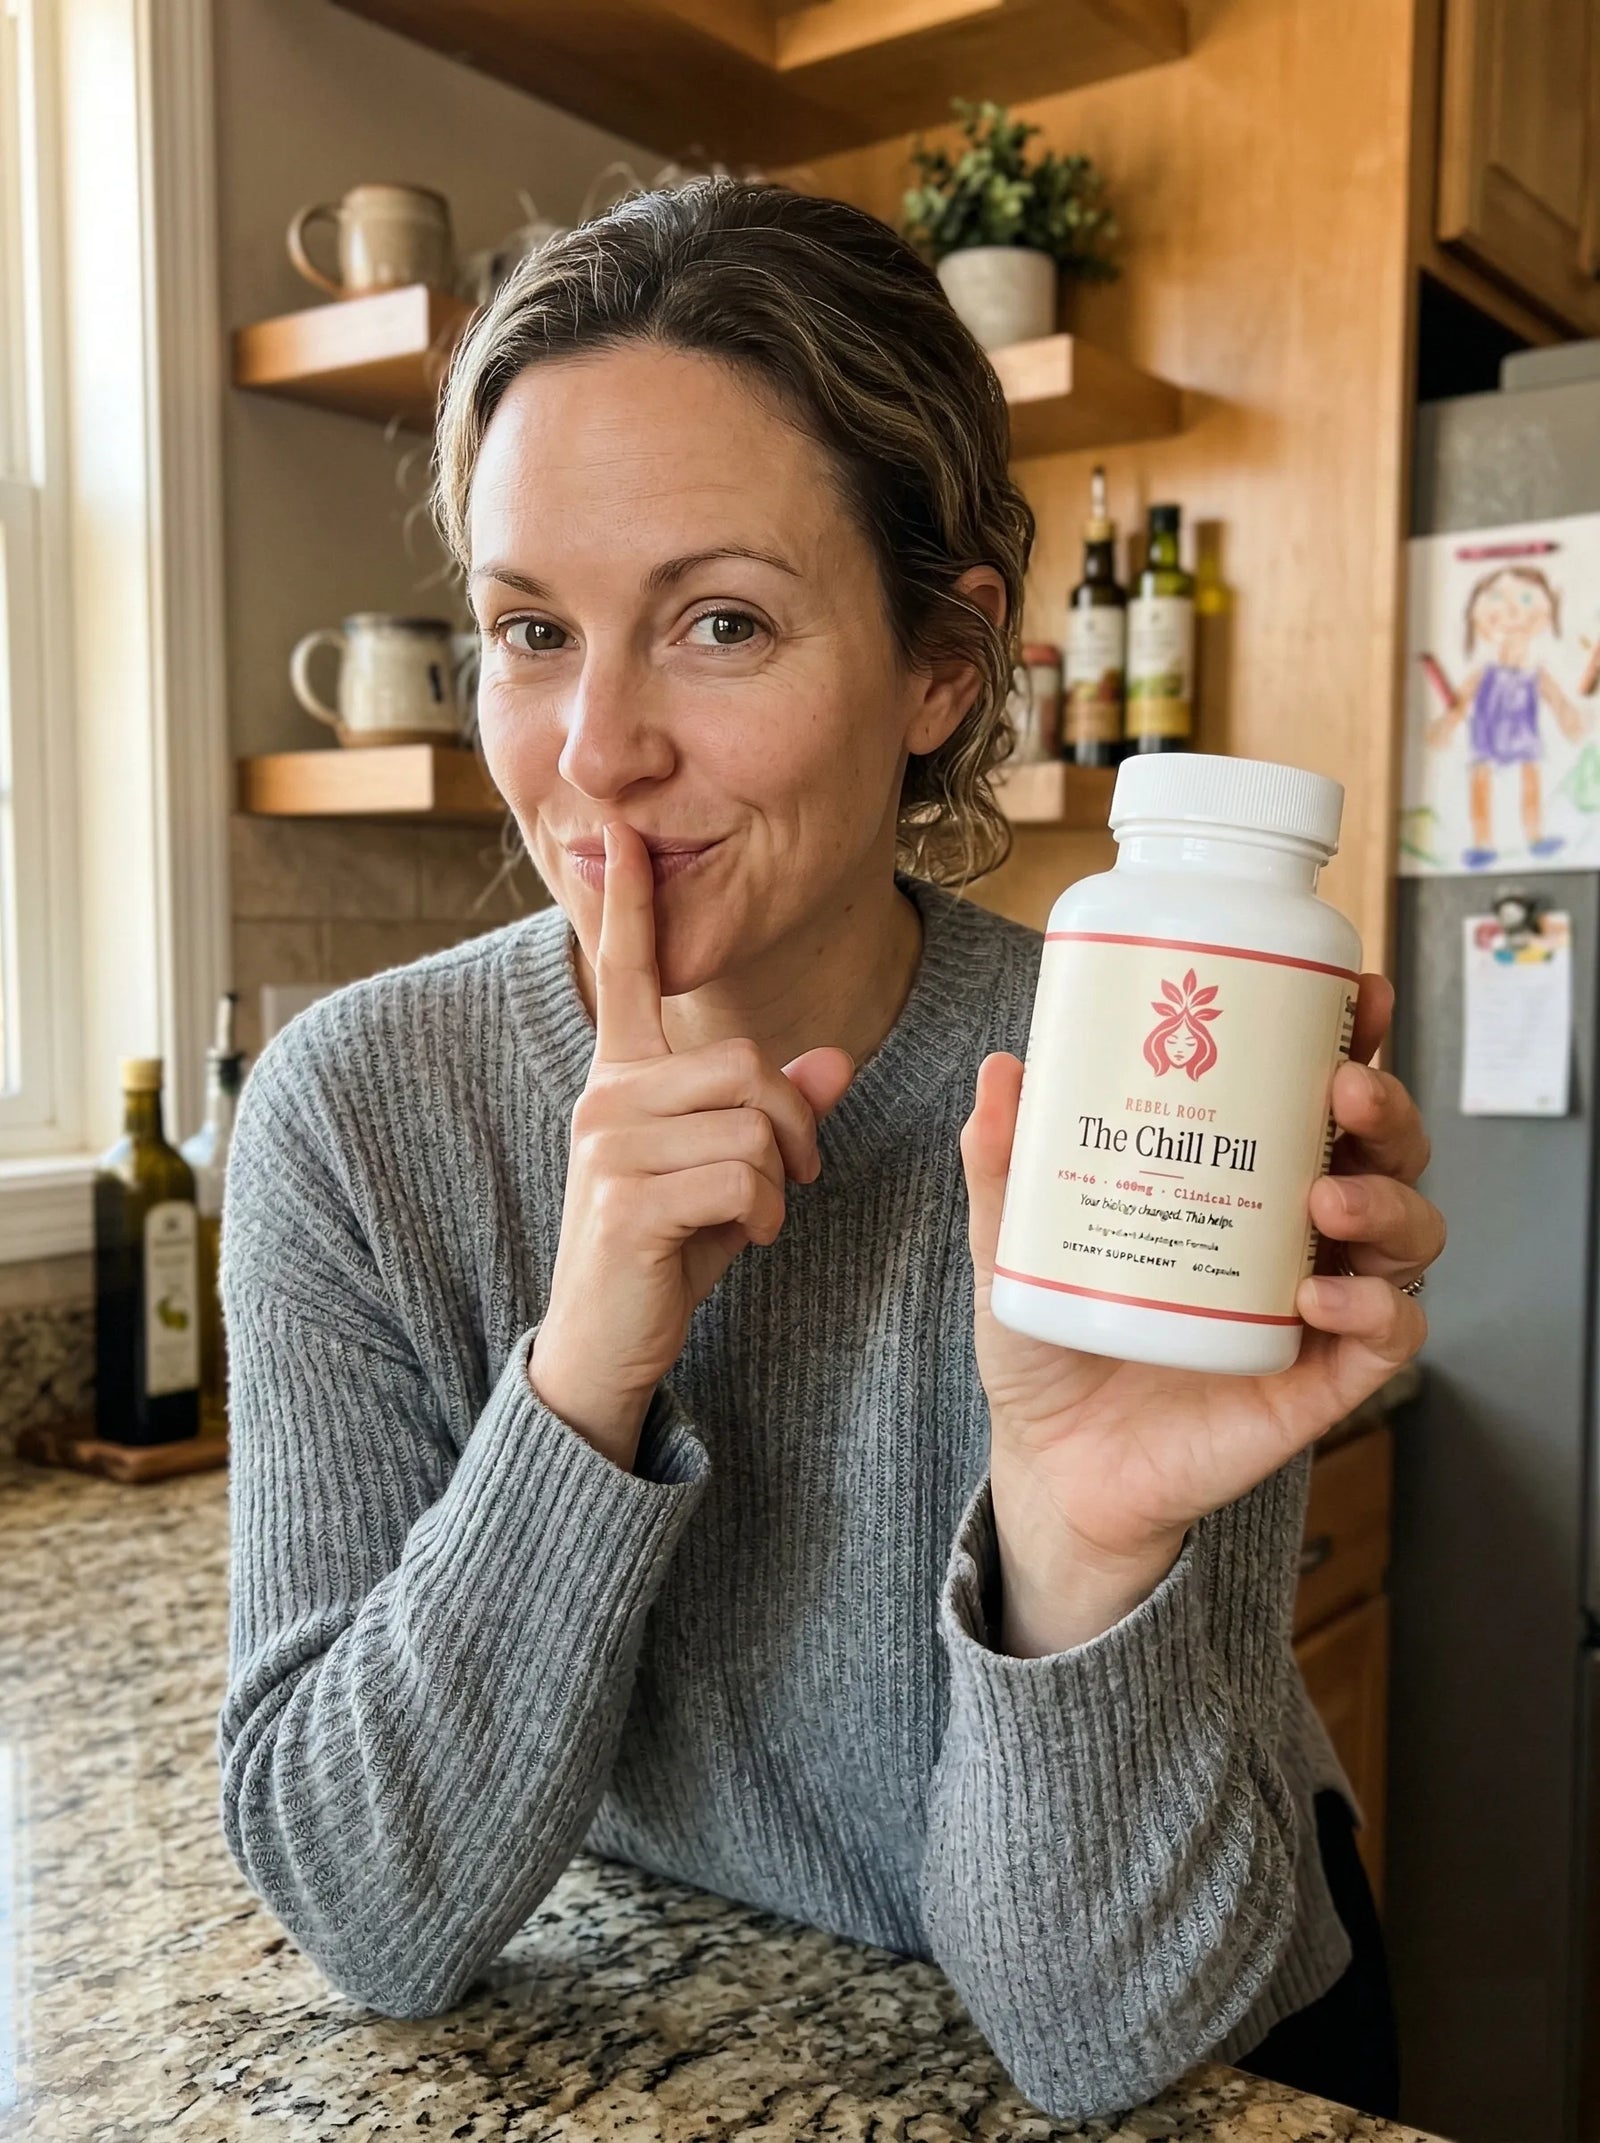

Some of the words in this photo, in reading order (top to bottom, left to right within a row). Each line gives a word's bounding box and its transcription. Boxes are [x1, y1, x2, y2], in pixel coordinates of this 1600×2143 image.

[1125, 1097, 1171, 1116] REBEL
[1176, 1104, 1217, 1122] ROOT
[1079, 1116, 1128, 1153] The
[1135, 1125, 1204, 1165] Chill
[1210, 1135, 1257, 1172] Pill
[1058, 1169, 1097, 1185] KSM-66
[1115, 1179, 1154, 1197] 600mg
[1174, 1188, 1232, 1207] Clinical
[1080, 1193, 1101, 1207] Your
[1185, 1210, 1206, 1225] This
[1062, 1241, 1104, 1256] DIETARY
[1105, 1249, 1178, 1268] SUPPLEMENT
[1186, 1239, 1219, 1252] Formula
[1192, 1263, 1204, 1273] 60
[1204, 1265, 1241, 1277] Capsules
